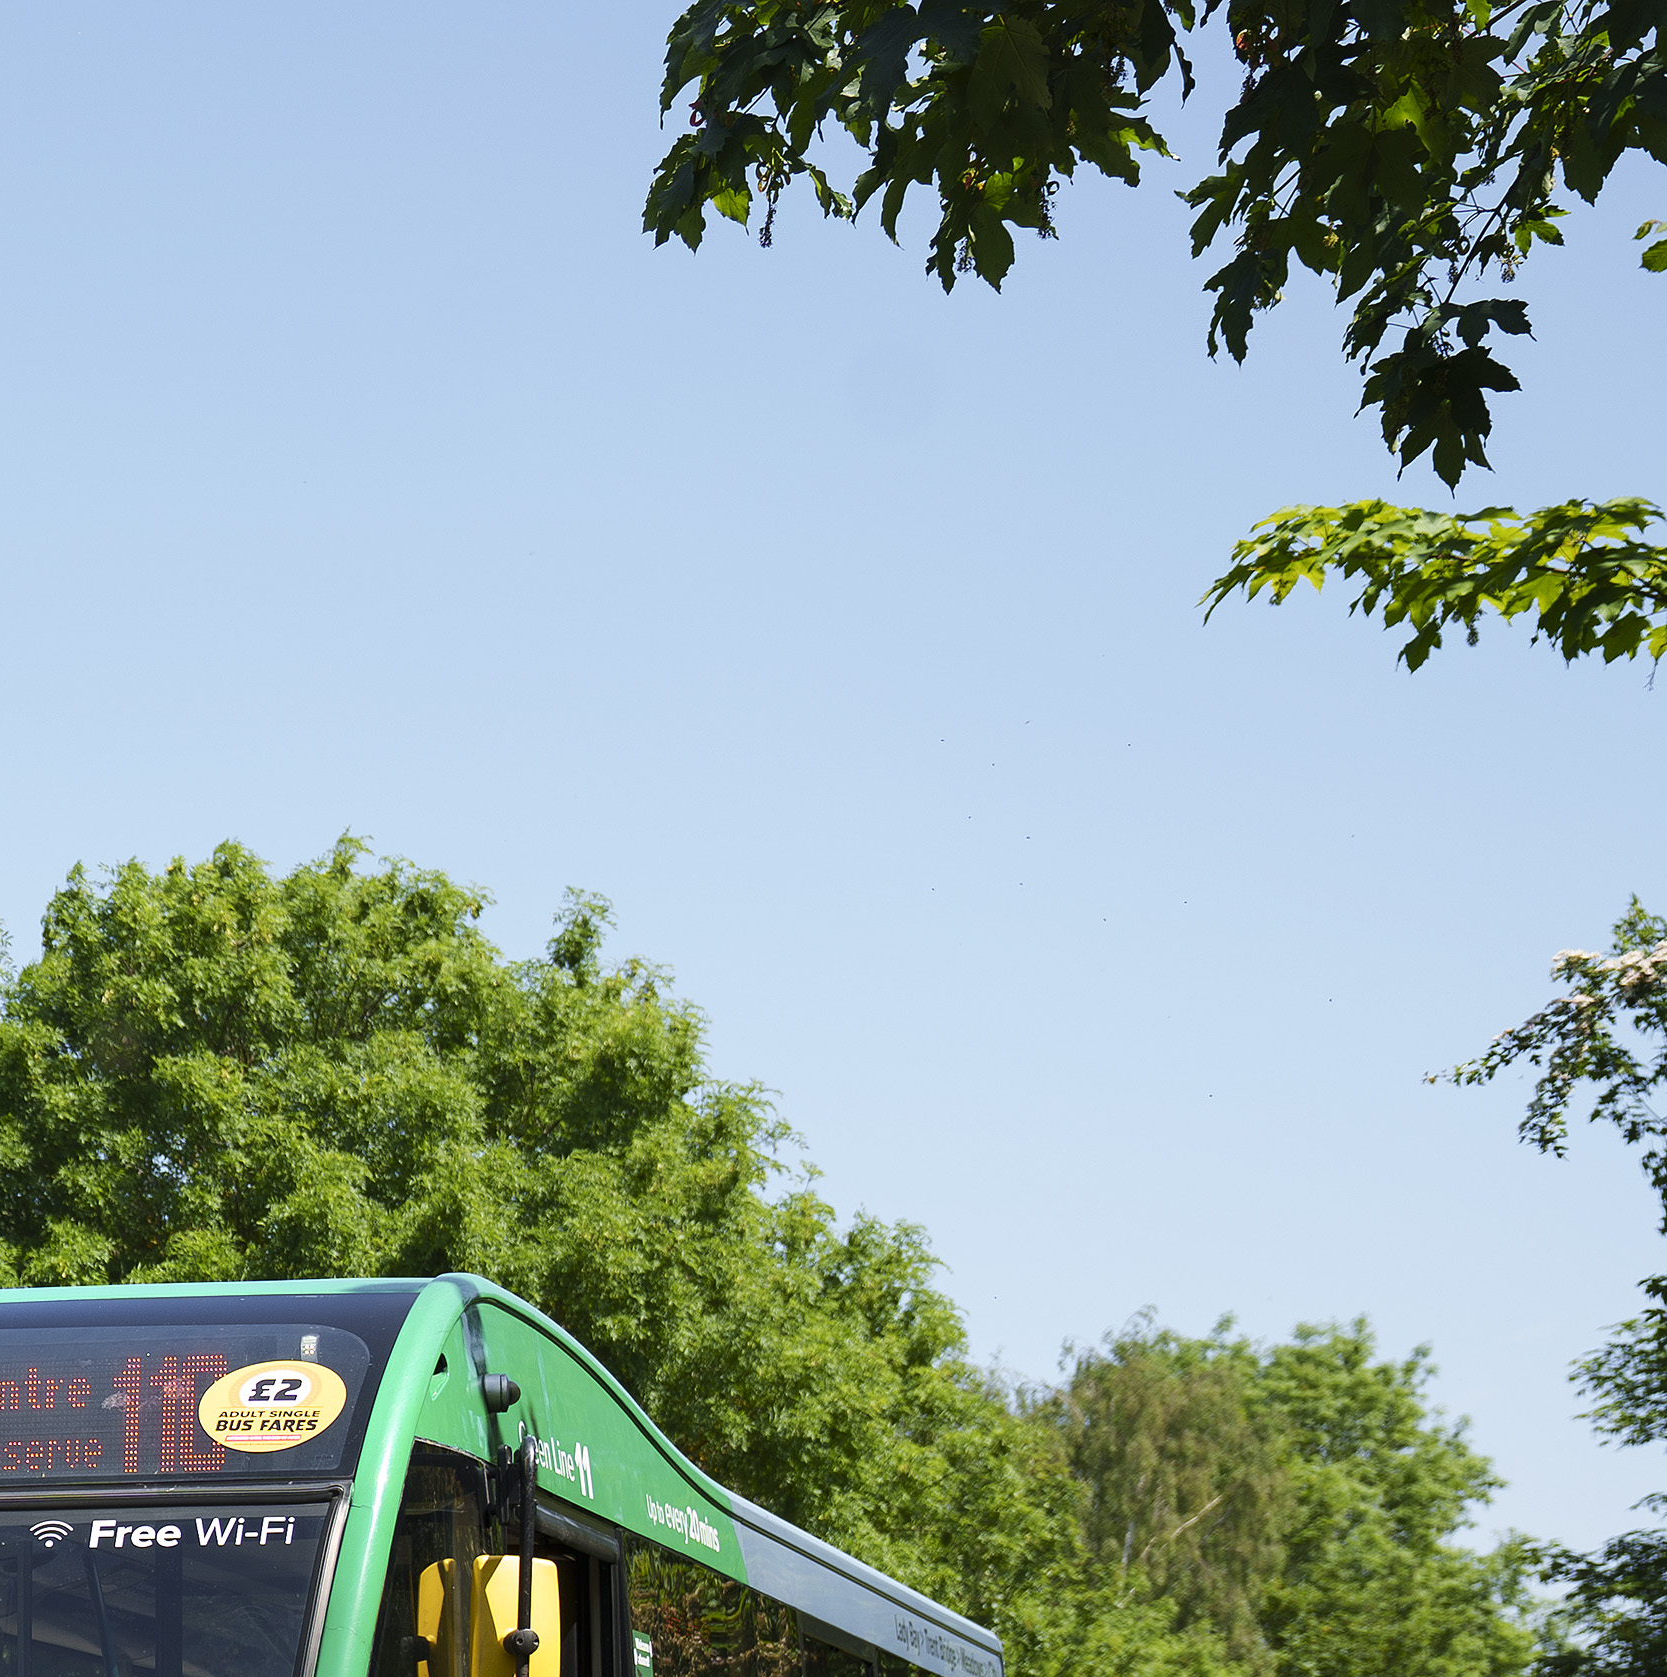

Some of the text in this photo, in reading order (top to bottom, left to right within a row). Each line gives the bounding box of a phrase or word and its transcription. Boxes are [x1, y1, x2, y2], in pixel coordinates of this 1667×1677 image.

[248, 1378, 303, 1401] £2
[215, 1419, 319, 1432] BUS FARES
[218, 1410, 321, 1418] ADULT SINGLE
[551, 1437, 575, 1482] Line
[575, 1441, 595, 1500] 11
[89, 1516, 296, 1548] Free Wi-Fi
[664, 1503, 689, 1545] every
